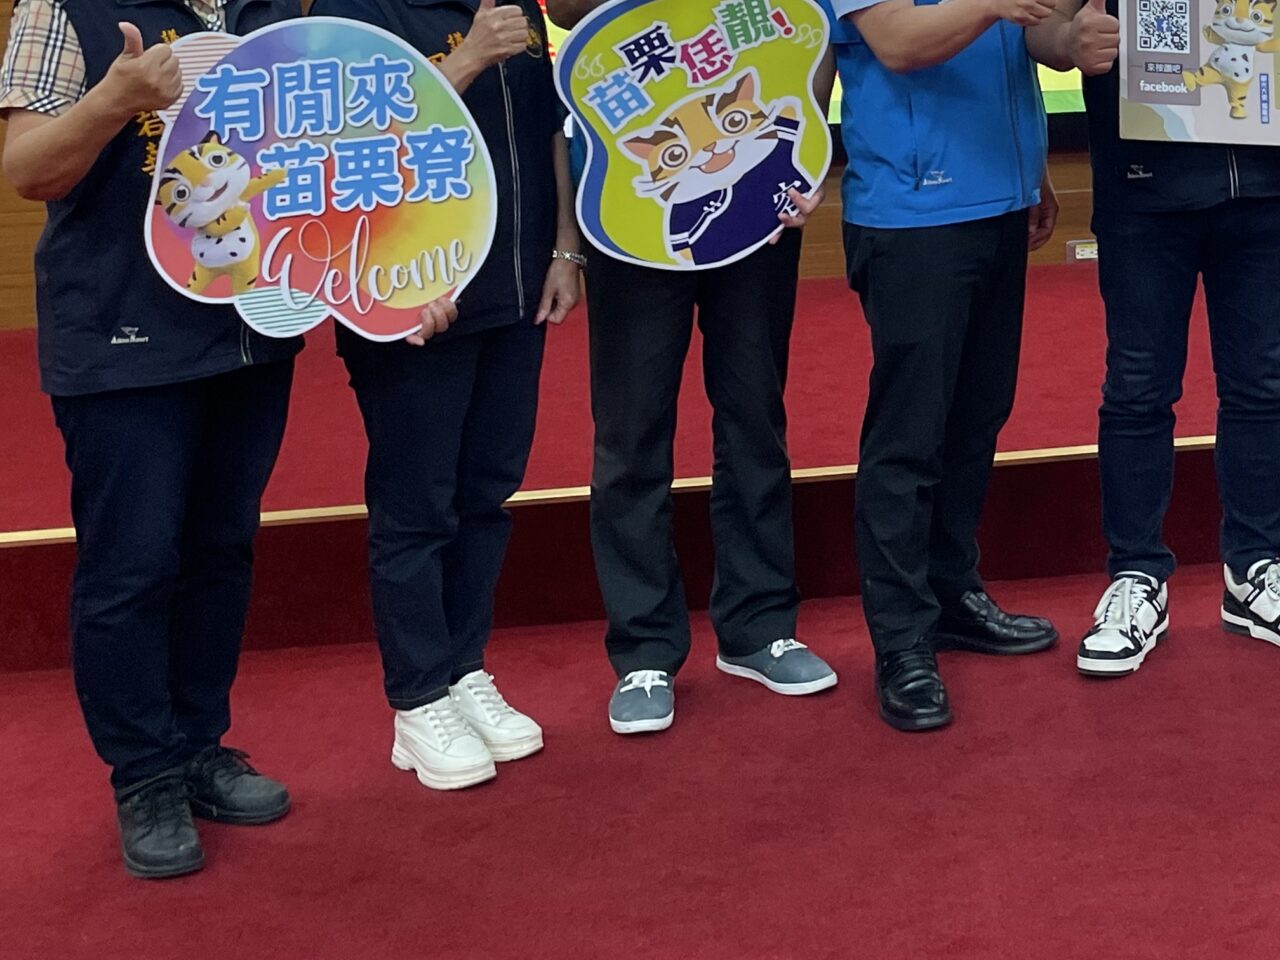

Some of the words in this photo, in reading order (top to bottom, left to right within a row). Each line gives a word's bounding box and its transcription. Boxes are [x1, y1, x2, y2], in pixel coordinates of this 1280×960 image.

[196, 55, 417, 141] 有閒來
[1139, 80, 1189, 94] facebook
[261, 215, 472, 314] Welcome
